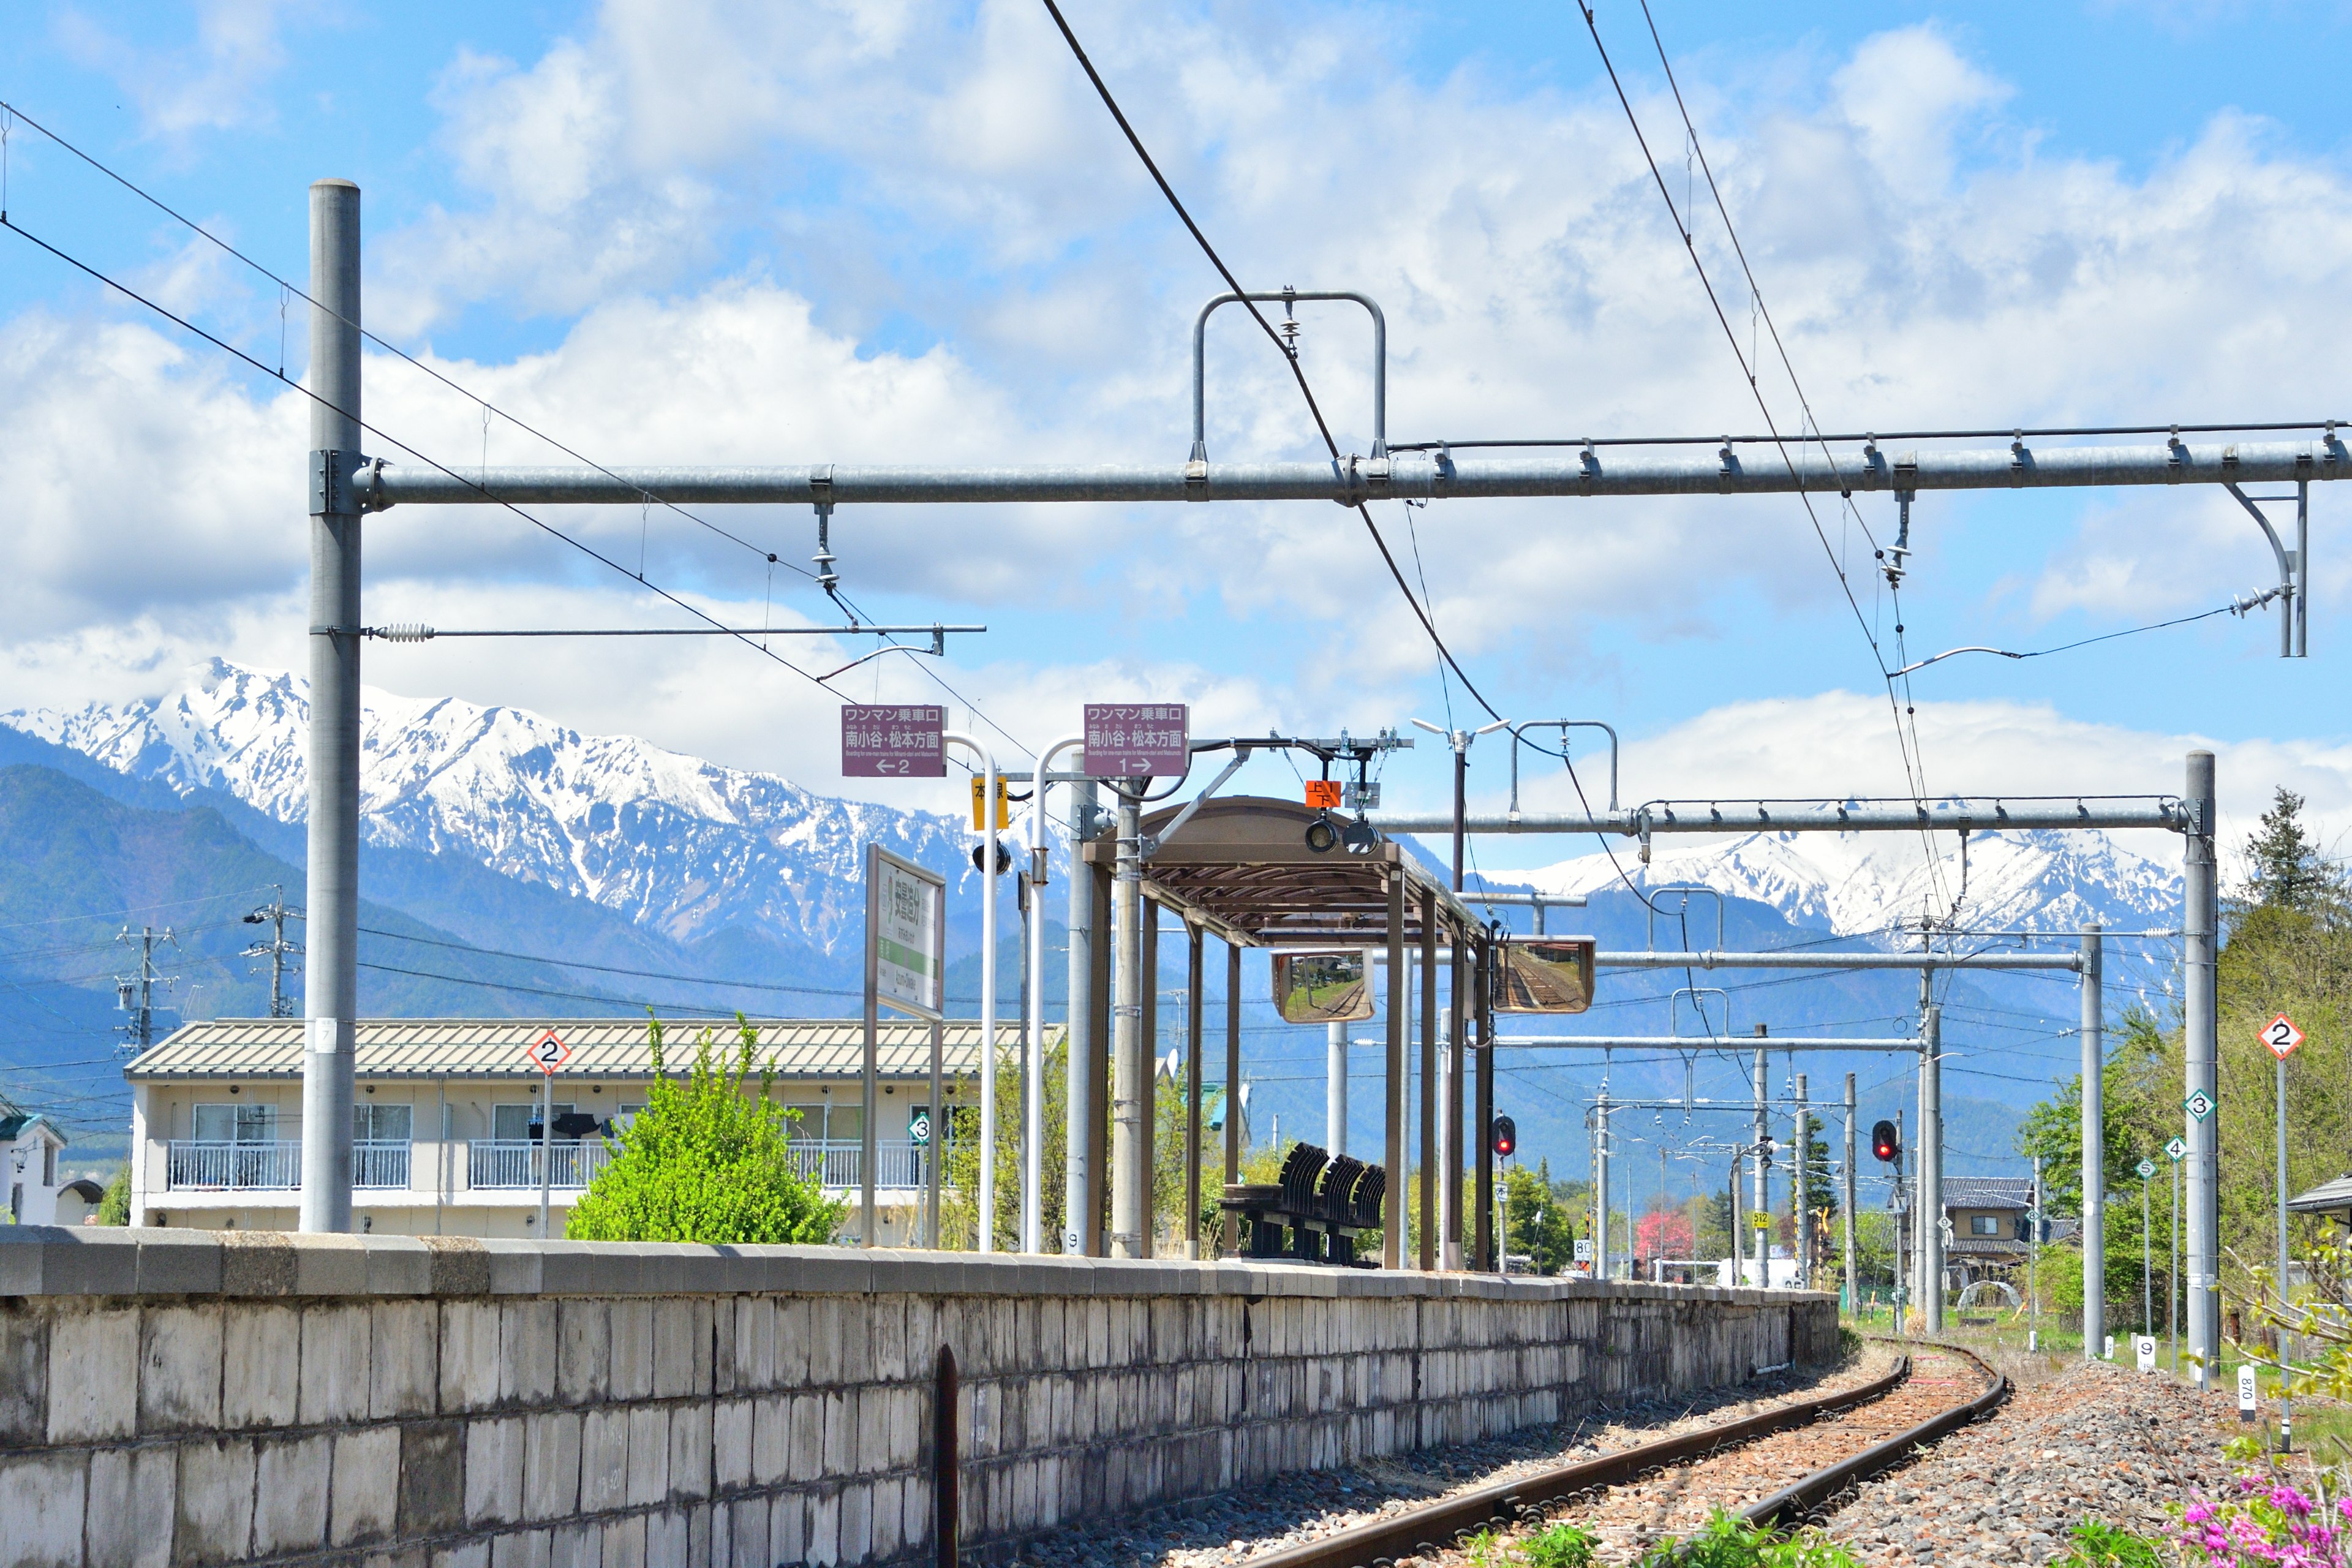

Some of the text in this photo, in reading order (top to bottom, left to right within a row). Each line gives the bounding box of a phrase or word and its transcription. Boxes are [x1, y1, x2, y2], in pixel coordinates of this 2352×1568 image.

[845, 709, 938, 722] ワンマン乗車口
[1088, 707, 1182, 720] ワンマン乗車口
[845, 731, 939, 748] 南小谷・松本方面
[1088, 729, 1182, 747] 南小谷・松本方面
[899, 760, 909, 774] 2
[1119, 758, 1126, 772] 1
[1316, 795, 1330, 805] 下
[2272, 1023, 2290, 1045] 2
[541, 1041, 558, 1061] 2
[2193, 1098, 2206, 1114] 3
[916, 1121, 928, 1137] 3
[2170, 1142, 2180, 1155] 4
[2141, 1164, 2150, 1173] 5
[1754, 1213, 1768, 1223] 512
[1942, 1218, 1948, 1227] 9
[1069, 1234, 1077, 1248] 9
[2140, 1342, 2153, 1355] 9
[2241, 1378, 2253, 1400] 870
